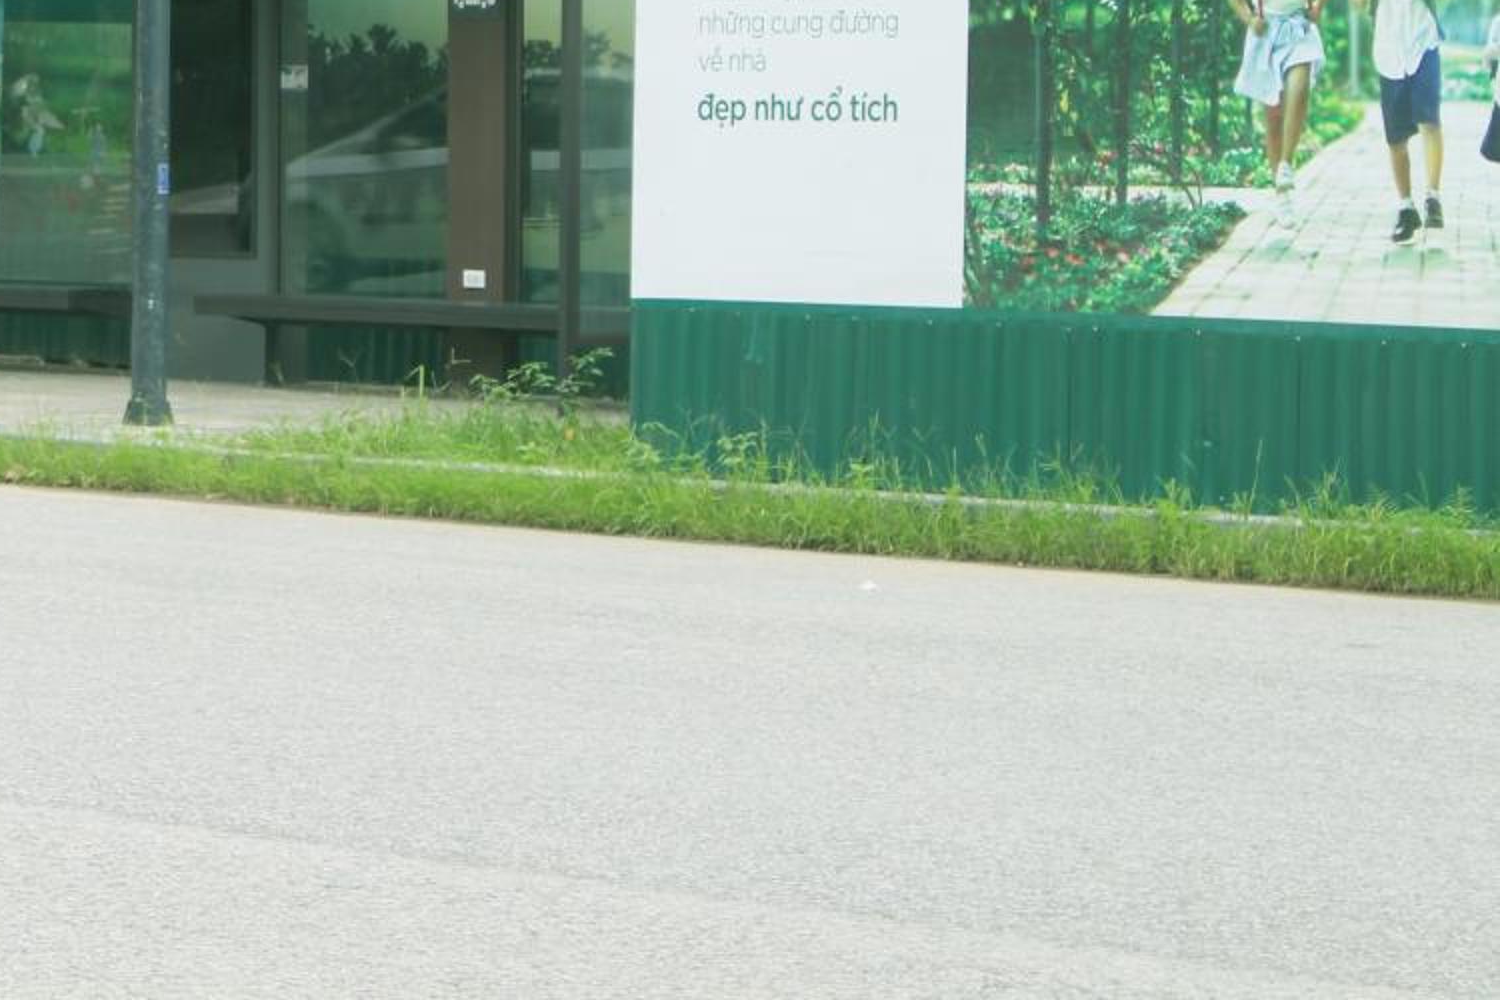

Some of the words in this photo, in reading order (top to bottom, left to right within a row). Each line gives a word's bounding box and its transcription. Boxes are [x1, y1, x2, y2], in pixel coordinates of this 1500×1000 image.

[698, 10, 765, 39] những
[771, 14, 824, 38] cung
[829, 10, 900, 38] đường
[698, 46, 723, 73] về
[728, 47, 767, 73] nhà
[697, 92, 747, 129] đẹp
[754, 92, 805, 122] như
[810, 85, 844, 122] cổ
[850, 91, 899, 122] tích
